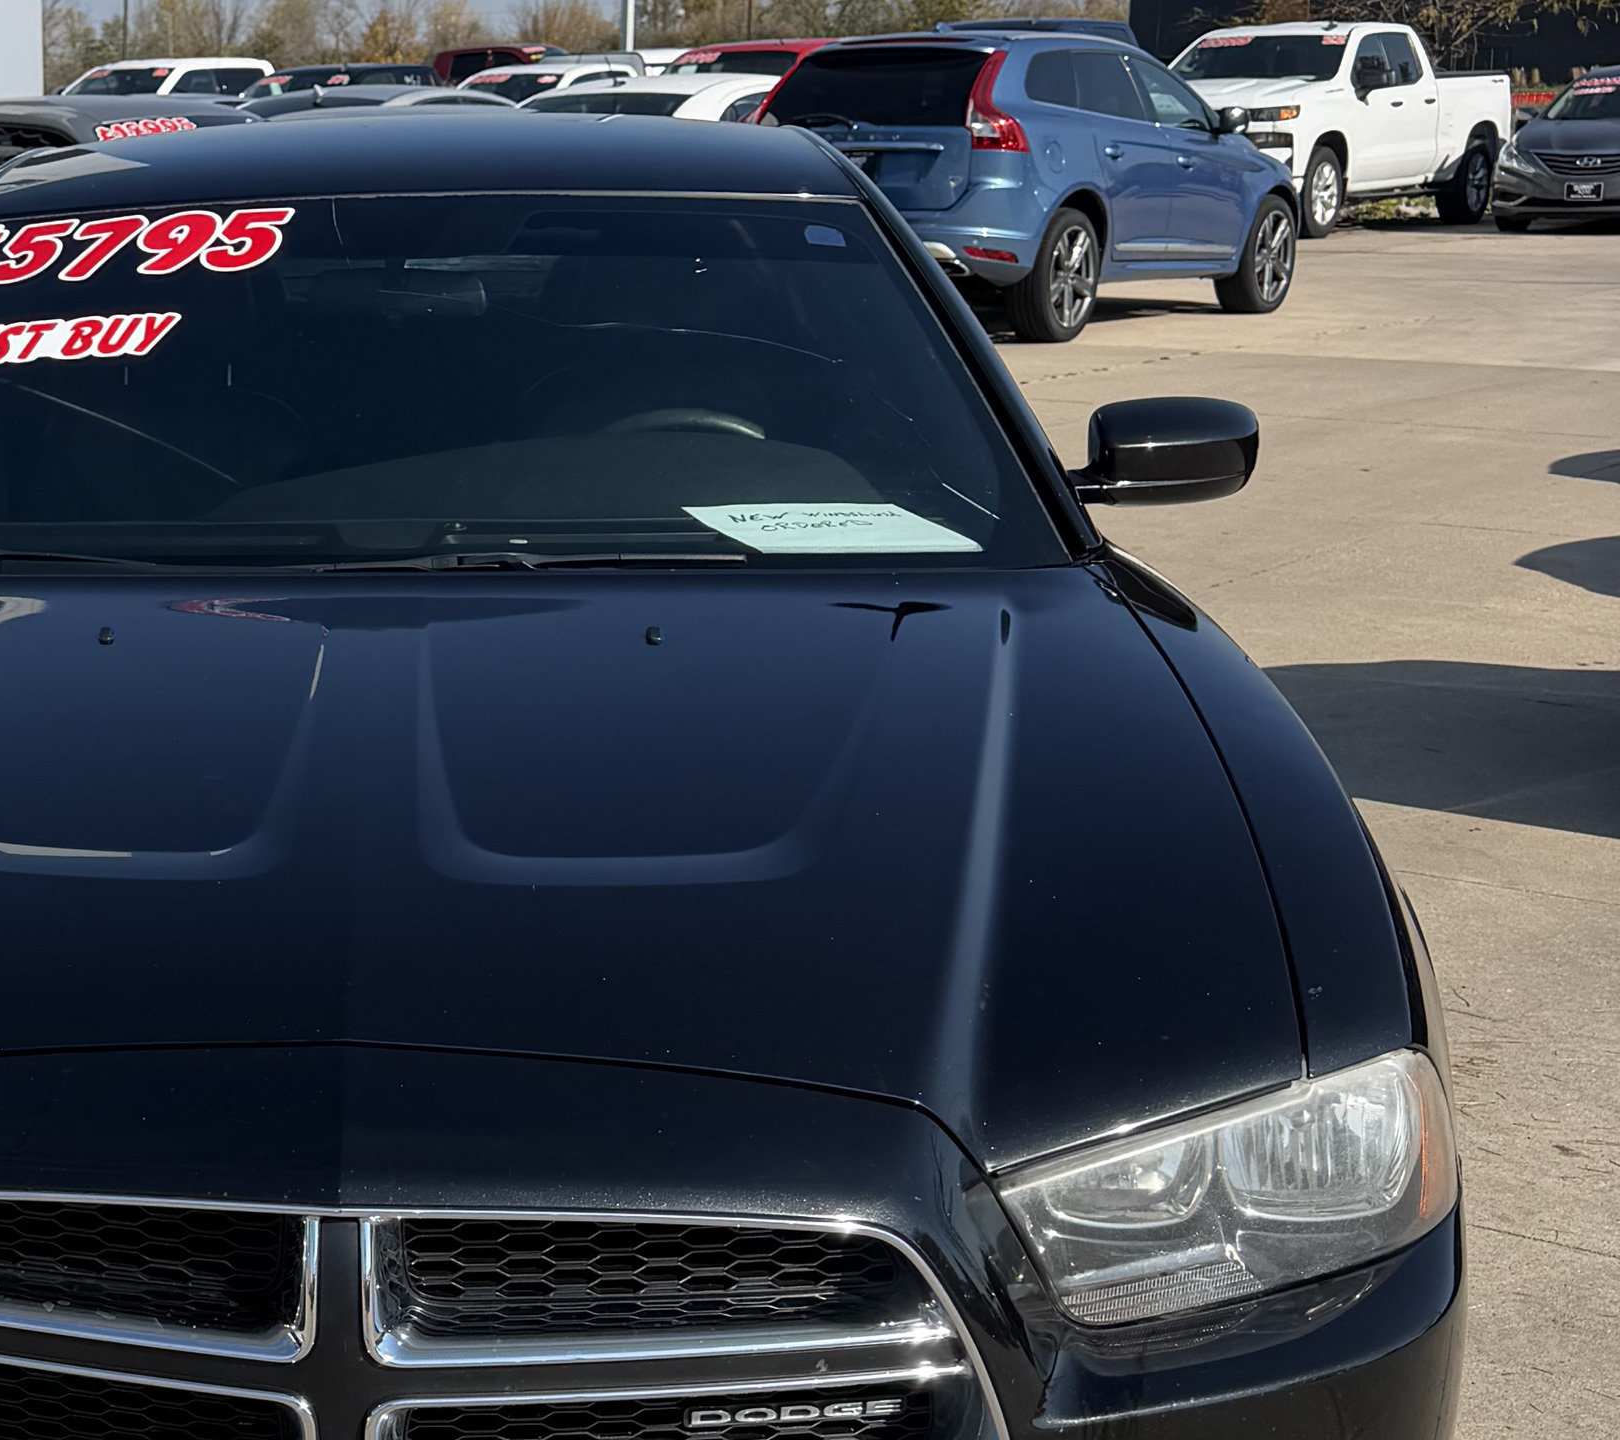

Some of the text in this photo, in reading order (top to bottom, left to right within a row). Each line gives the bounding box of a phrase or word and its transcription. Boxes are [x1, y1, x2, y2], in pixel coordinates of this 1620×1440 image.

[62, 313, 180, 359] BUY
[728, 511, 788, 524] NEW
[691, 1398, 902, 1427] DODGE
